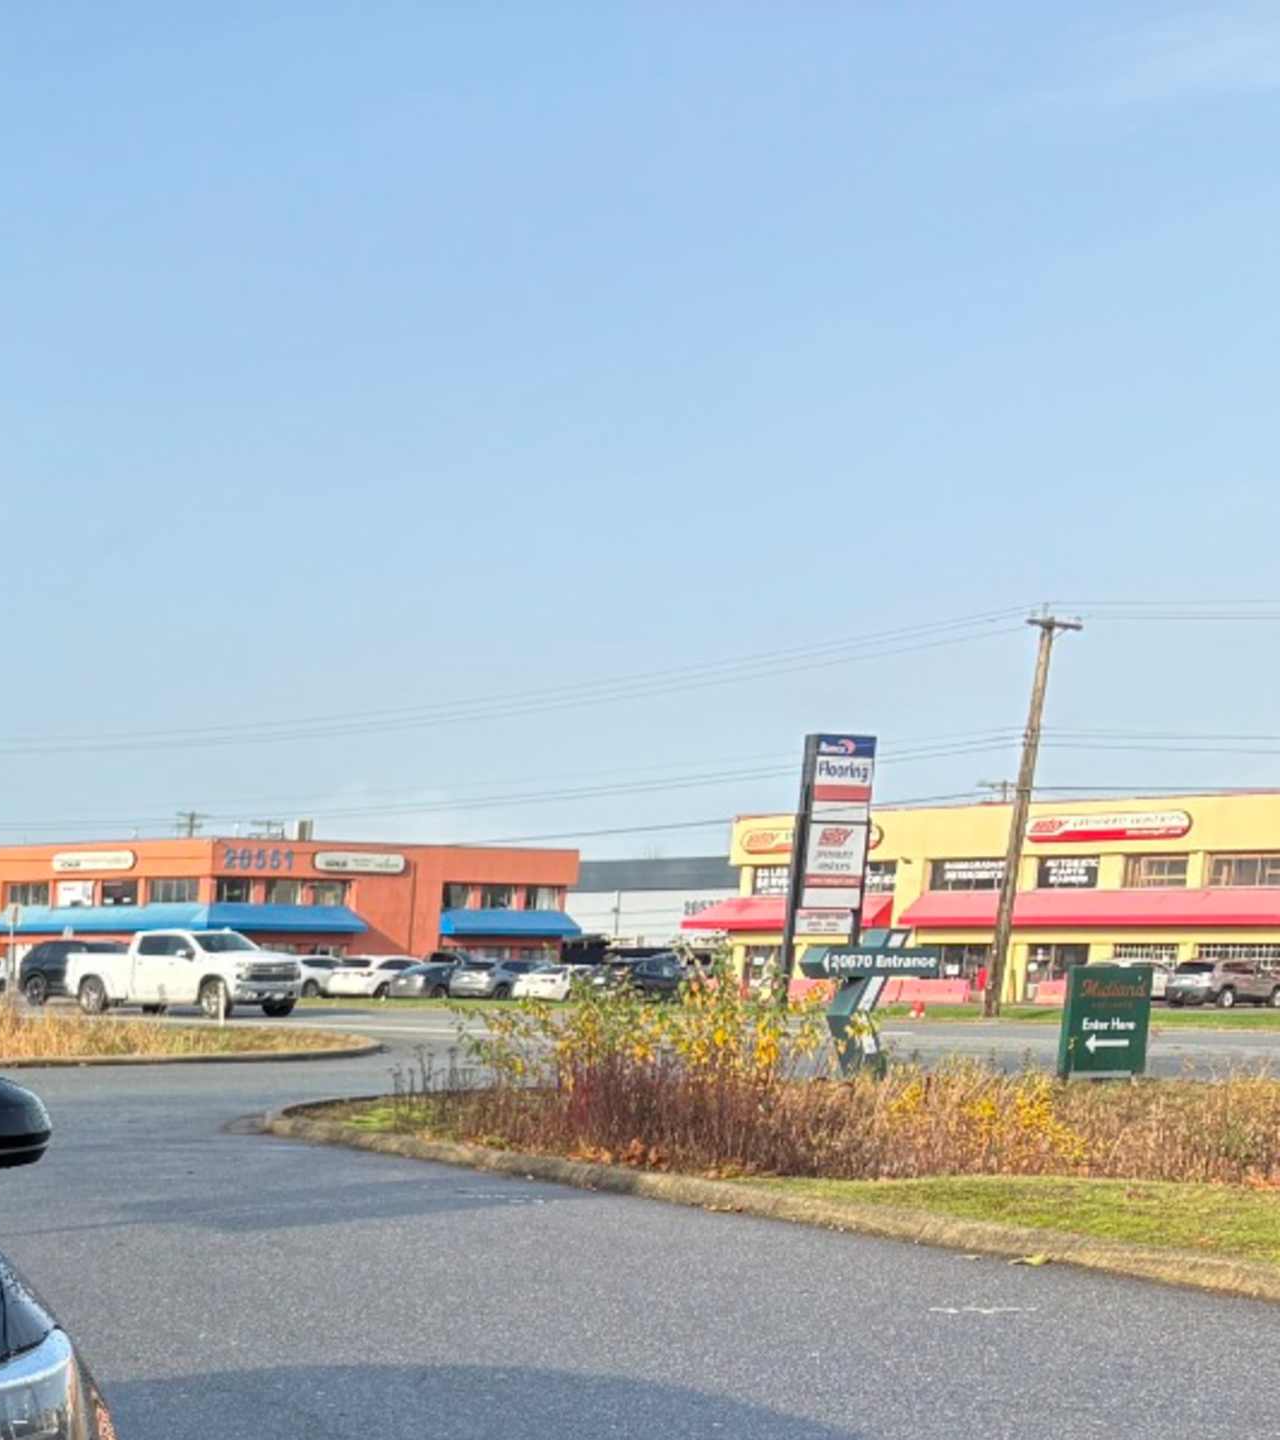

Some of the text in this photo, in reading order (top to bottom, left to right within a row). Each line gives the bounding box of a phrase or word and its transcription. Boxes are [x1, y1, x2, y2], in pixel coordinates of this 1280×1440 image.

[818, 760, 869, 782] Flooring
[876, 954, 937, 968] Entrance
[1082, 1016, 1136, 1031] Enter Here
